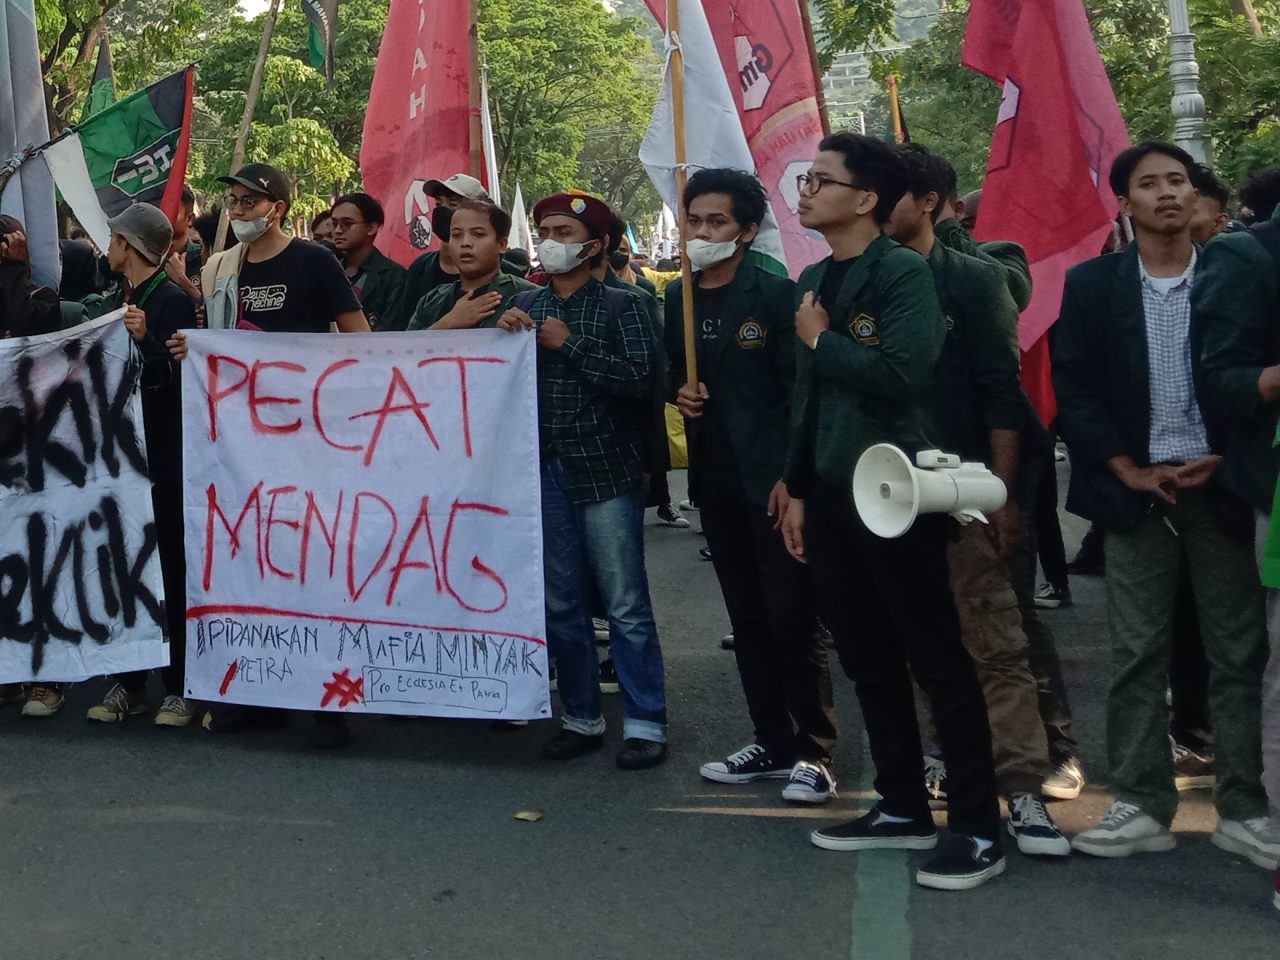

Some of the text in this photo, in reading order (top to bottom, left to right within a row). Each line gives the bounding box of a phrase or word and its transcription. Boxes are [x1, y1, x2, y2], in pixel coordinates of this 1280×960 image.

[205, 353, 511, 467] PECAT
[203, 480, 509, 614] MENDAG
[367, 668, 391, 702] Pro
[436, 630, 543, 681] MINYAK
